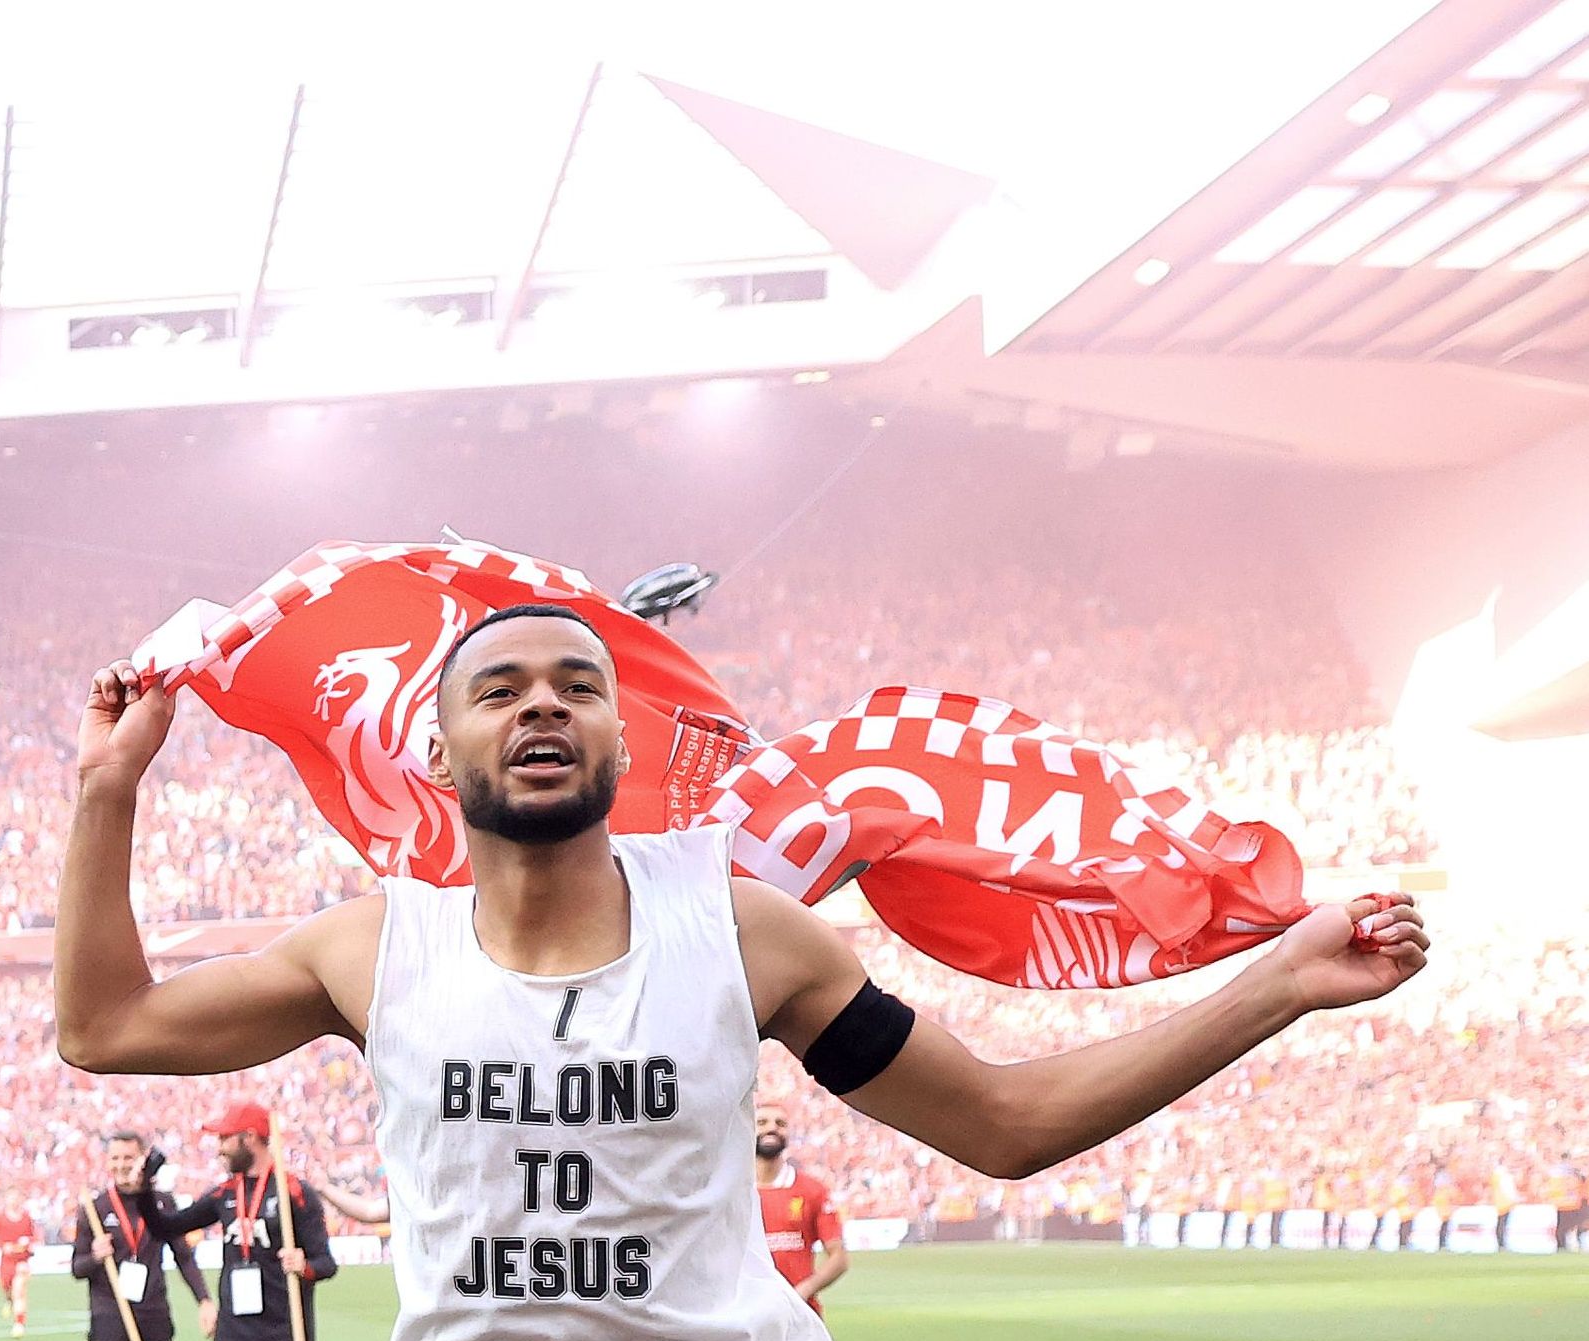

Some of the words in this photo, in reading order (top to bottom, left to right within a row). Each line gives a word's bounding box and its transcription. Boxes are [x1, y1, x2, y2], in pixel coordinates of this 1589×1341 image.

[553, 986, 582, 1041] I
[440, 1056, 680, 1127] BELONG
[515, 1149, 593, 1214] TO
[454, 1235, 652, 1301] JESUS
